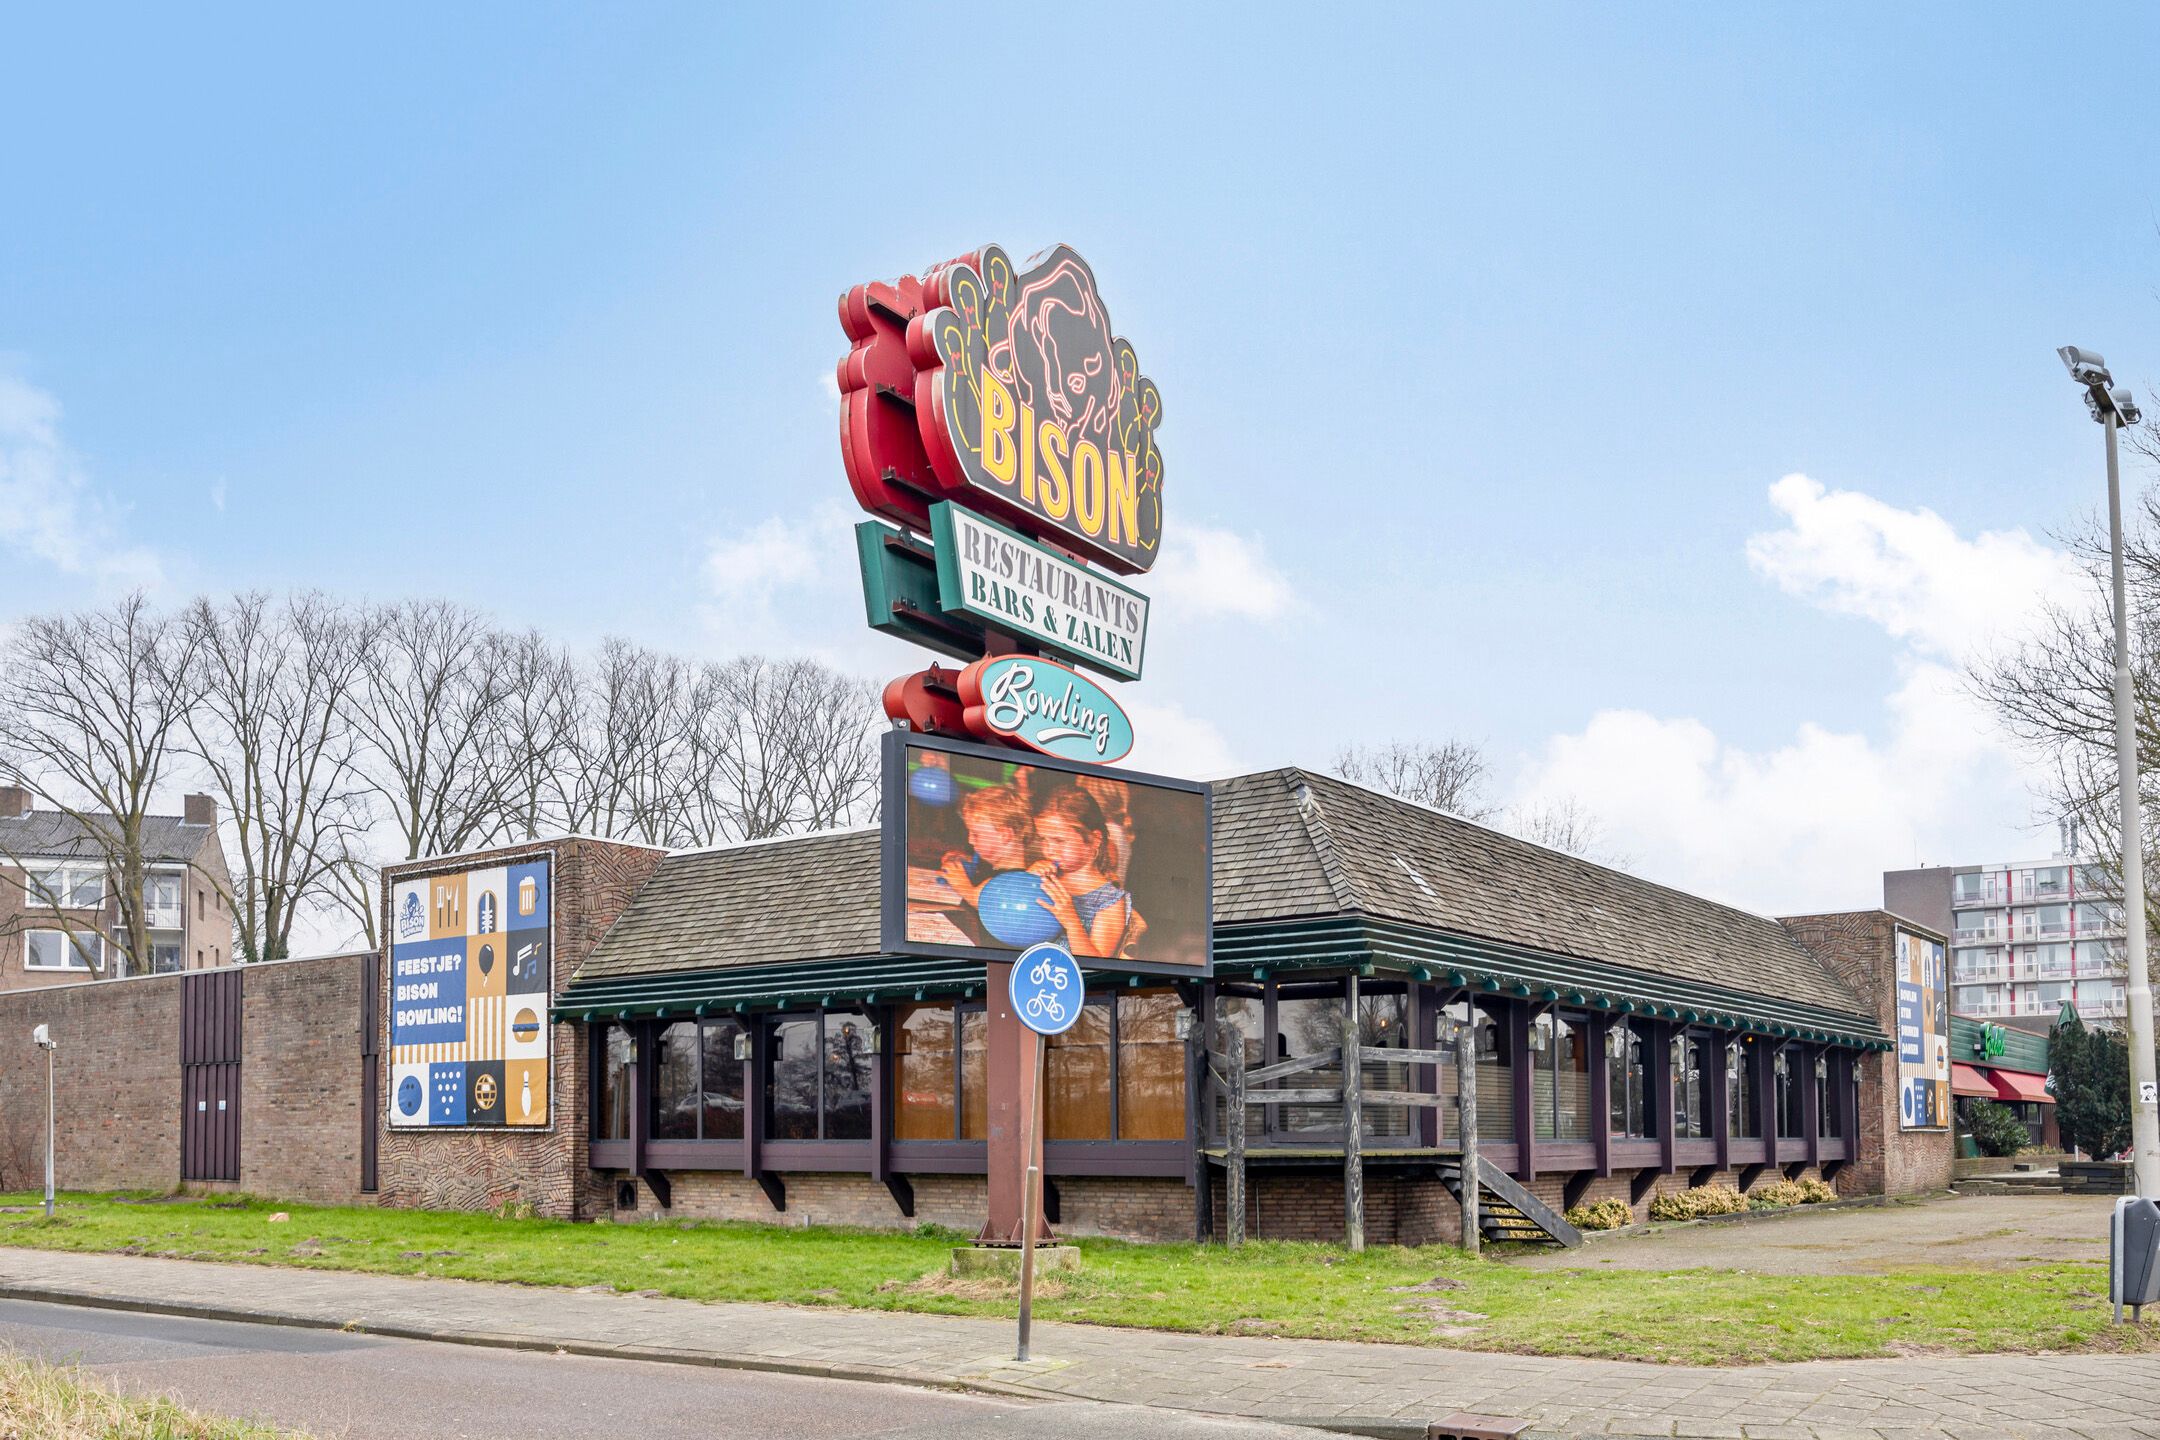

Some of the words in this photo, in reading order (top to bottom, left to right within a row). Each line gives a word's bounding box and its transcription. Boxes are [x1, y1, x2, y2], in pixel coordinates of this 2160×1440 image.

[981, 363, 1138, 548] BISON
[963, 522, 1139, 635] RESTAURANTS
[971, 570, 1035, 624] BARS
[1043, 604, 1059, 635] &
[1066, 613, 1133, 666] ZALEN
[986, 662, 1110, 756] Bowling
[401, 915, 424, 932] BISON
[396, 981, 439, 1002] BISON
[397, 953, 462, 977] FEESTJE?
[396, 1005, 463, 1027] BOWLING!
